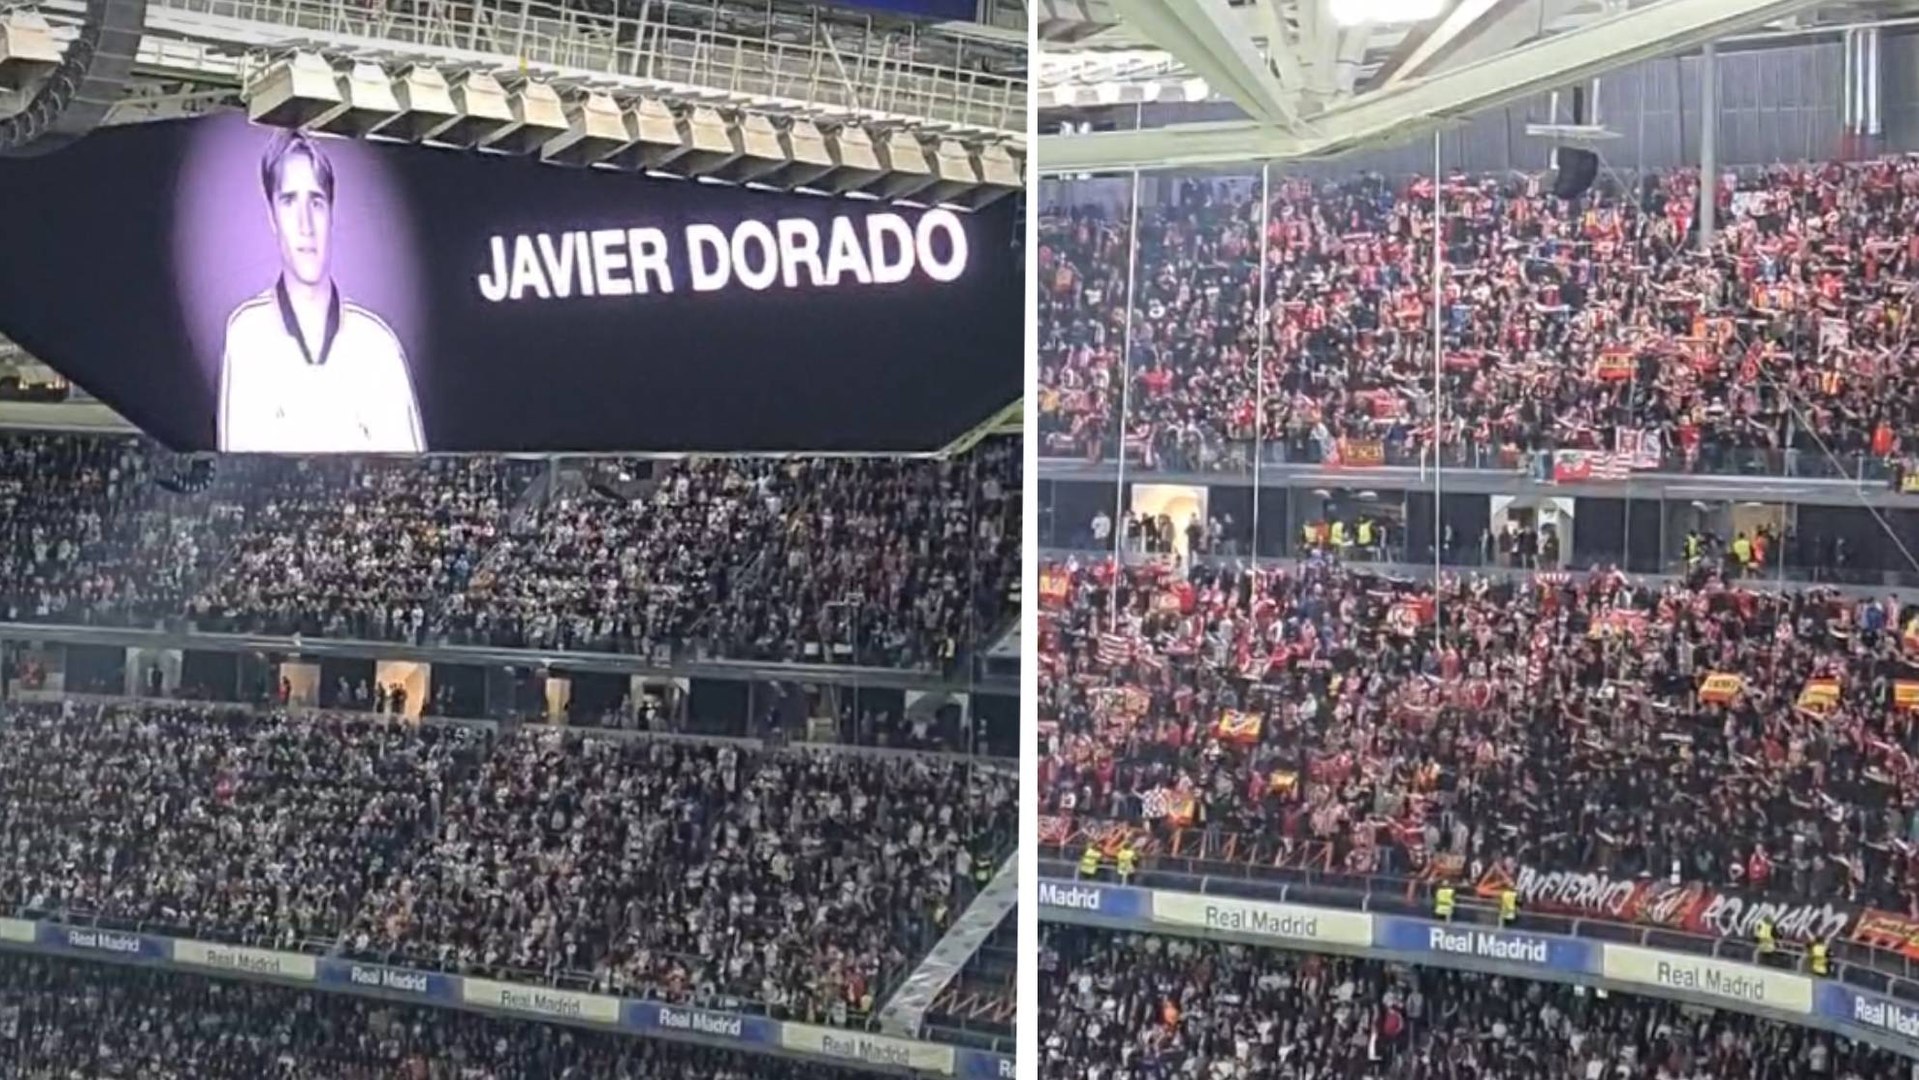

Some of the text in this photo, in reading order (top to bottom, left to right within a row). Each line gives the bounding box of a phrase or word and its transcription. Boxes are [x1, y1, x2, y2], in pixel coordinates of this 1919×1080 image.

[478, 208, 969, 302] JAVIER DORADO
[1039, 883, 1100, 910] Madrid
[1516, 864, 1635, 916] INFIERNO
[1205, 905, 1317, 937] Real Madrid
[69, 930, 139, 952] Real Madrid
[1429, 927, 1547, 962] Real Madrid
[207, 950, 280, 974] Real Madrid
[352, 966, 427, 992] Real Madrid
[1657, 961, 1765, 1000] Real Madrid
[501, 990, 580, 1017] Real Madrid
[1854, 996, 1919, 1038] Real Mad
[659, 1008, 742, 1036] Real Madrid
[822, 1034, 910, 1066] Real Madrid
